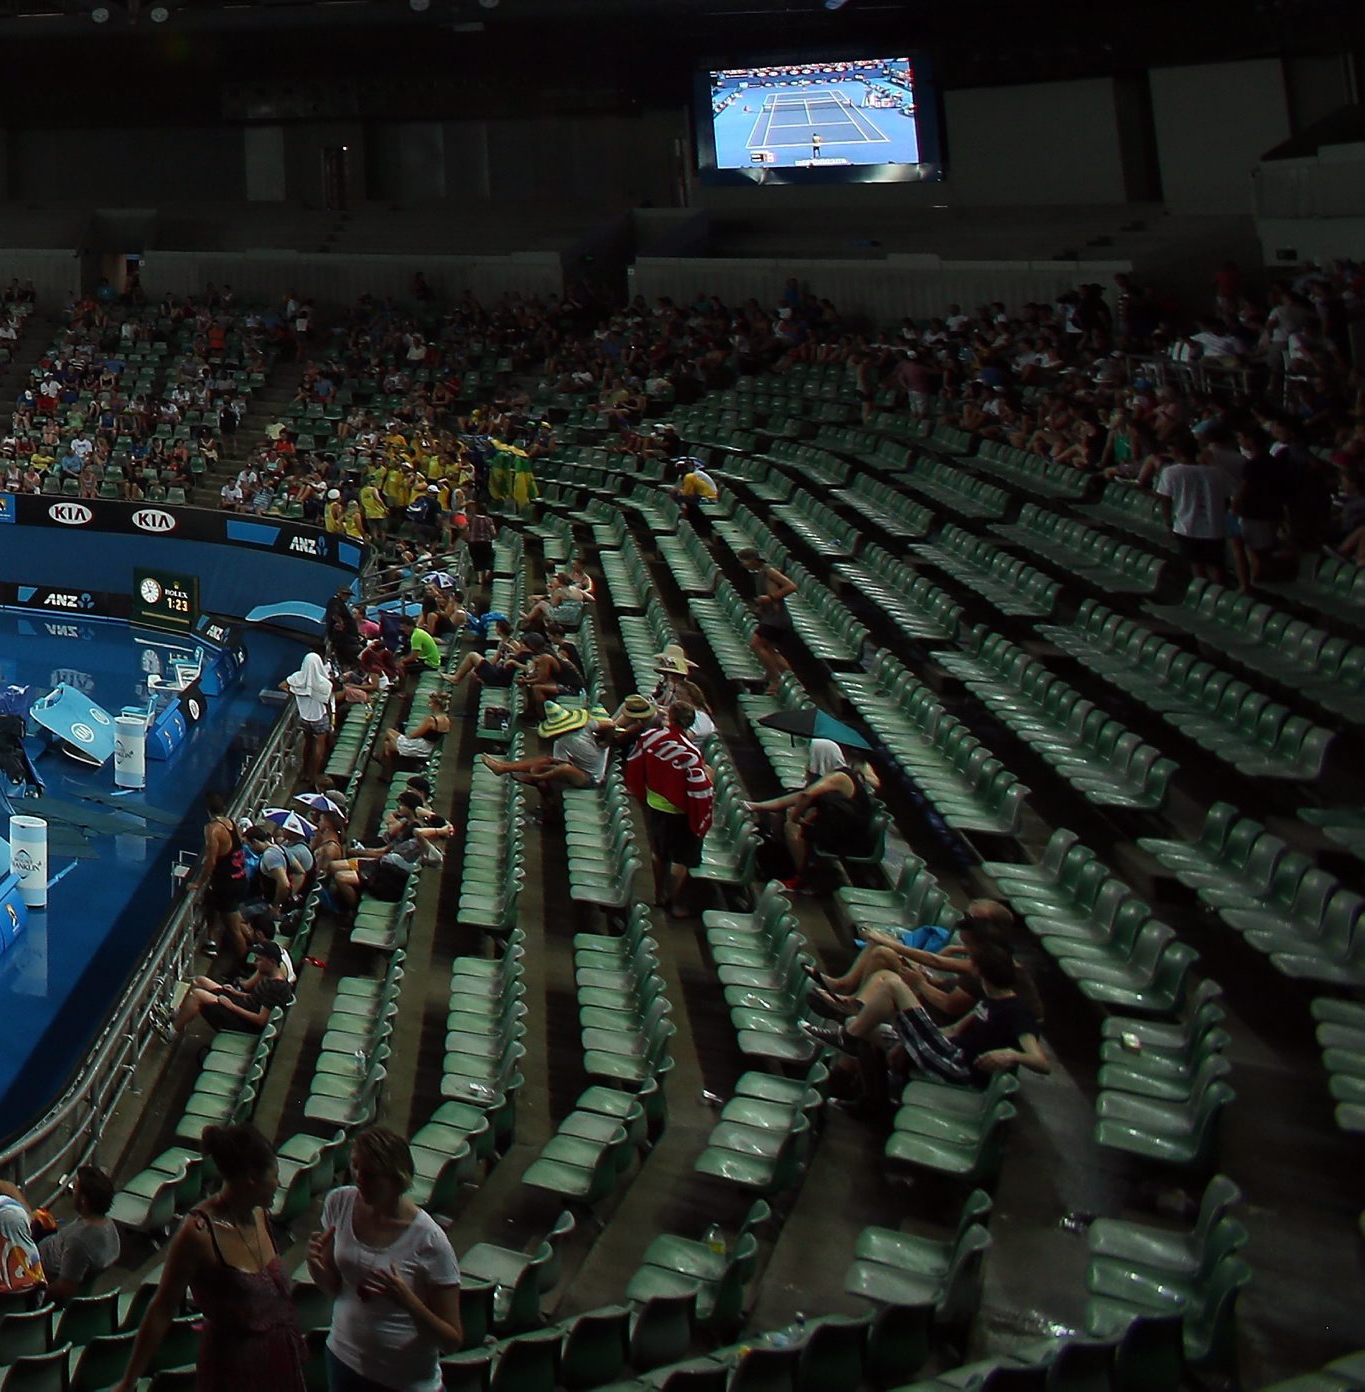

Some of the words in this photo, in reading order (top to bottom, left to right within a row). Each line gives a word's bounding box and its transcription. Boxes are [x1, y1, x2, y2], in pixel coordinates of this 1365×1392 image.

[53, 506, 87, 520] KIA
[137, 513, 170, 528] KIA
[289, 536, 317, 555] ANZ
[43, 592, 79, 608] ANZ
[165, 588, 189, 599] ROLEX
[167, 598, 189, 612] 1:23
